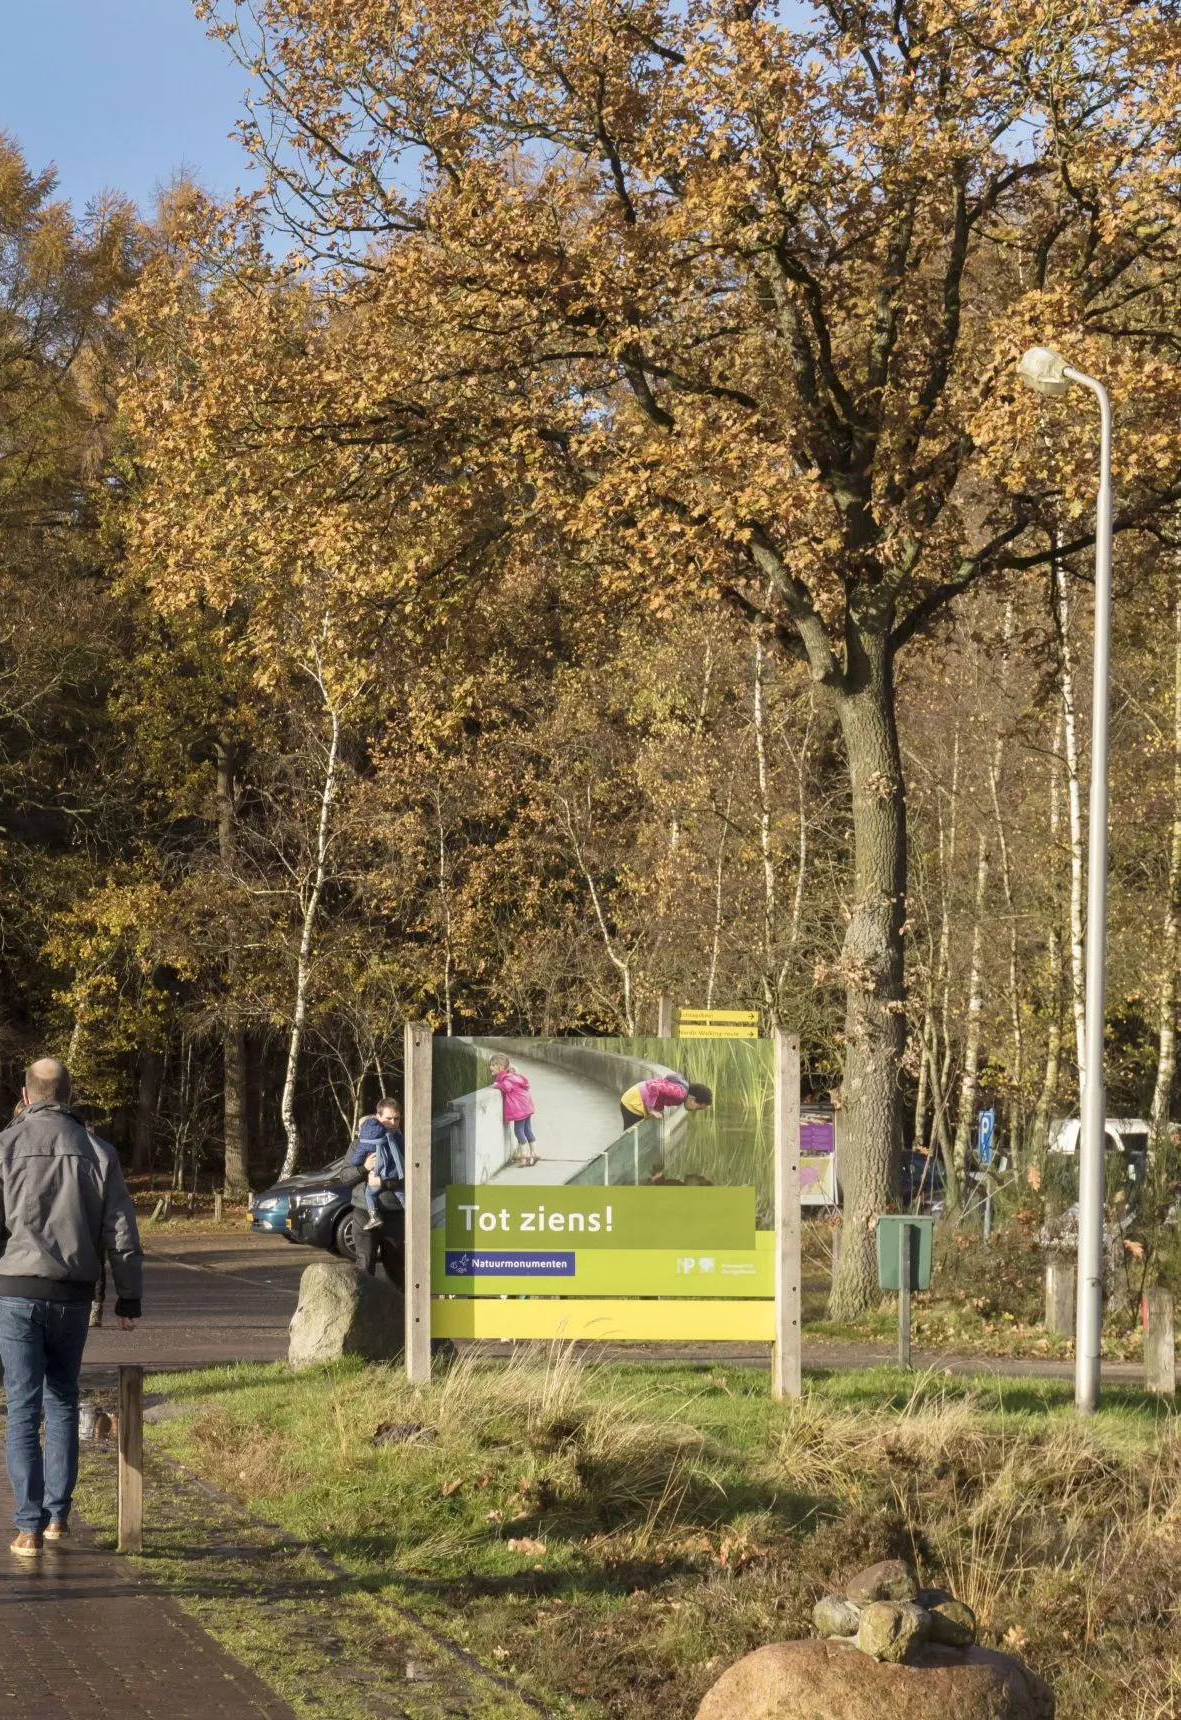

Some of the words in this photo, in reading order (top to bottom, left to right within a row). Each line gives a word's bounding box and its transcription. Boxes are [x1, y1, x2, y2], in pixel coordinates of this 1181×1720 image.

[982, 1117, 989, 1143] P
[458, 1204, 510, 1232] Tot
[520, 1205, 613, 1232] ziens!
[471, 1258, 568, 1269] Natuurmonumenten
